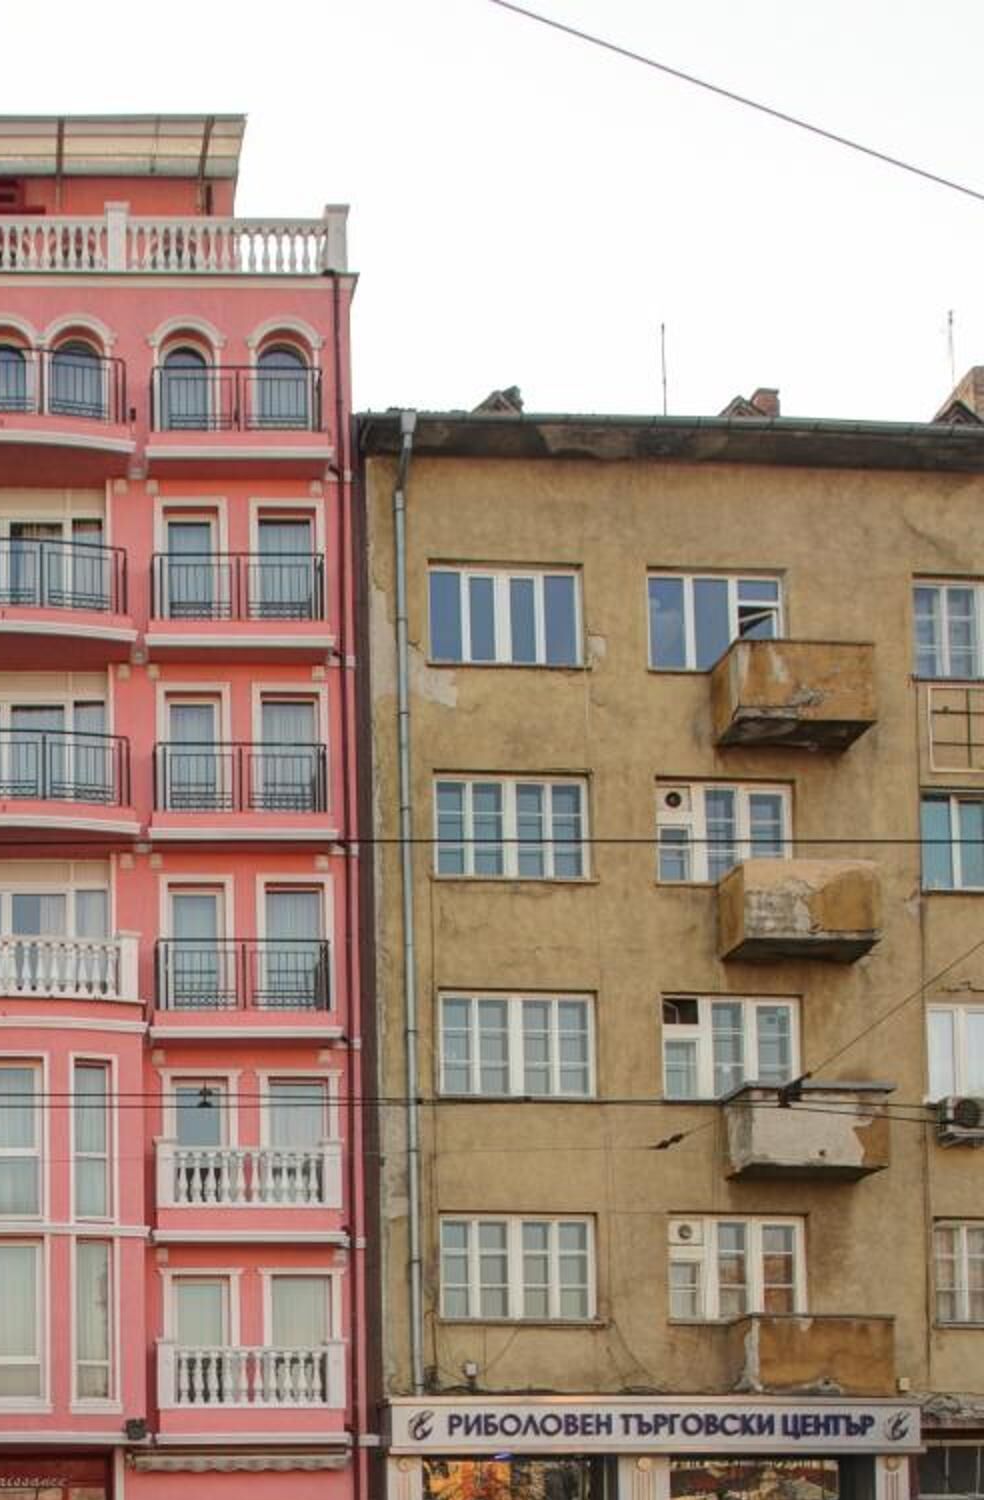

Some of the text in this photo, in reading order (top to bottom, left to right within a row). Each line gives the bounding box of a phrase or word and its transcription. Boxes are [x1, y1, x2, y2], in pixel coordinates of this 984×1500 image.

[447, 1414, 875, 1439] РИБОЛОВЕН ТЪРГОВСКИ ЦЕНТЪР
